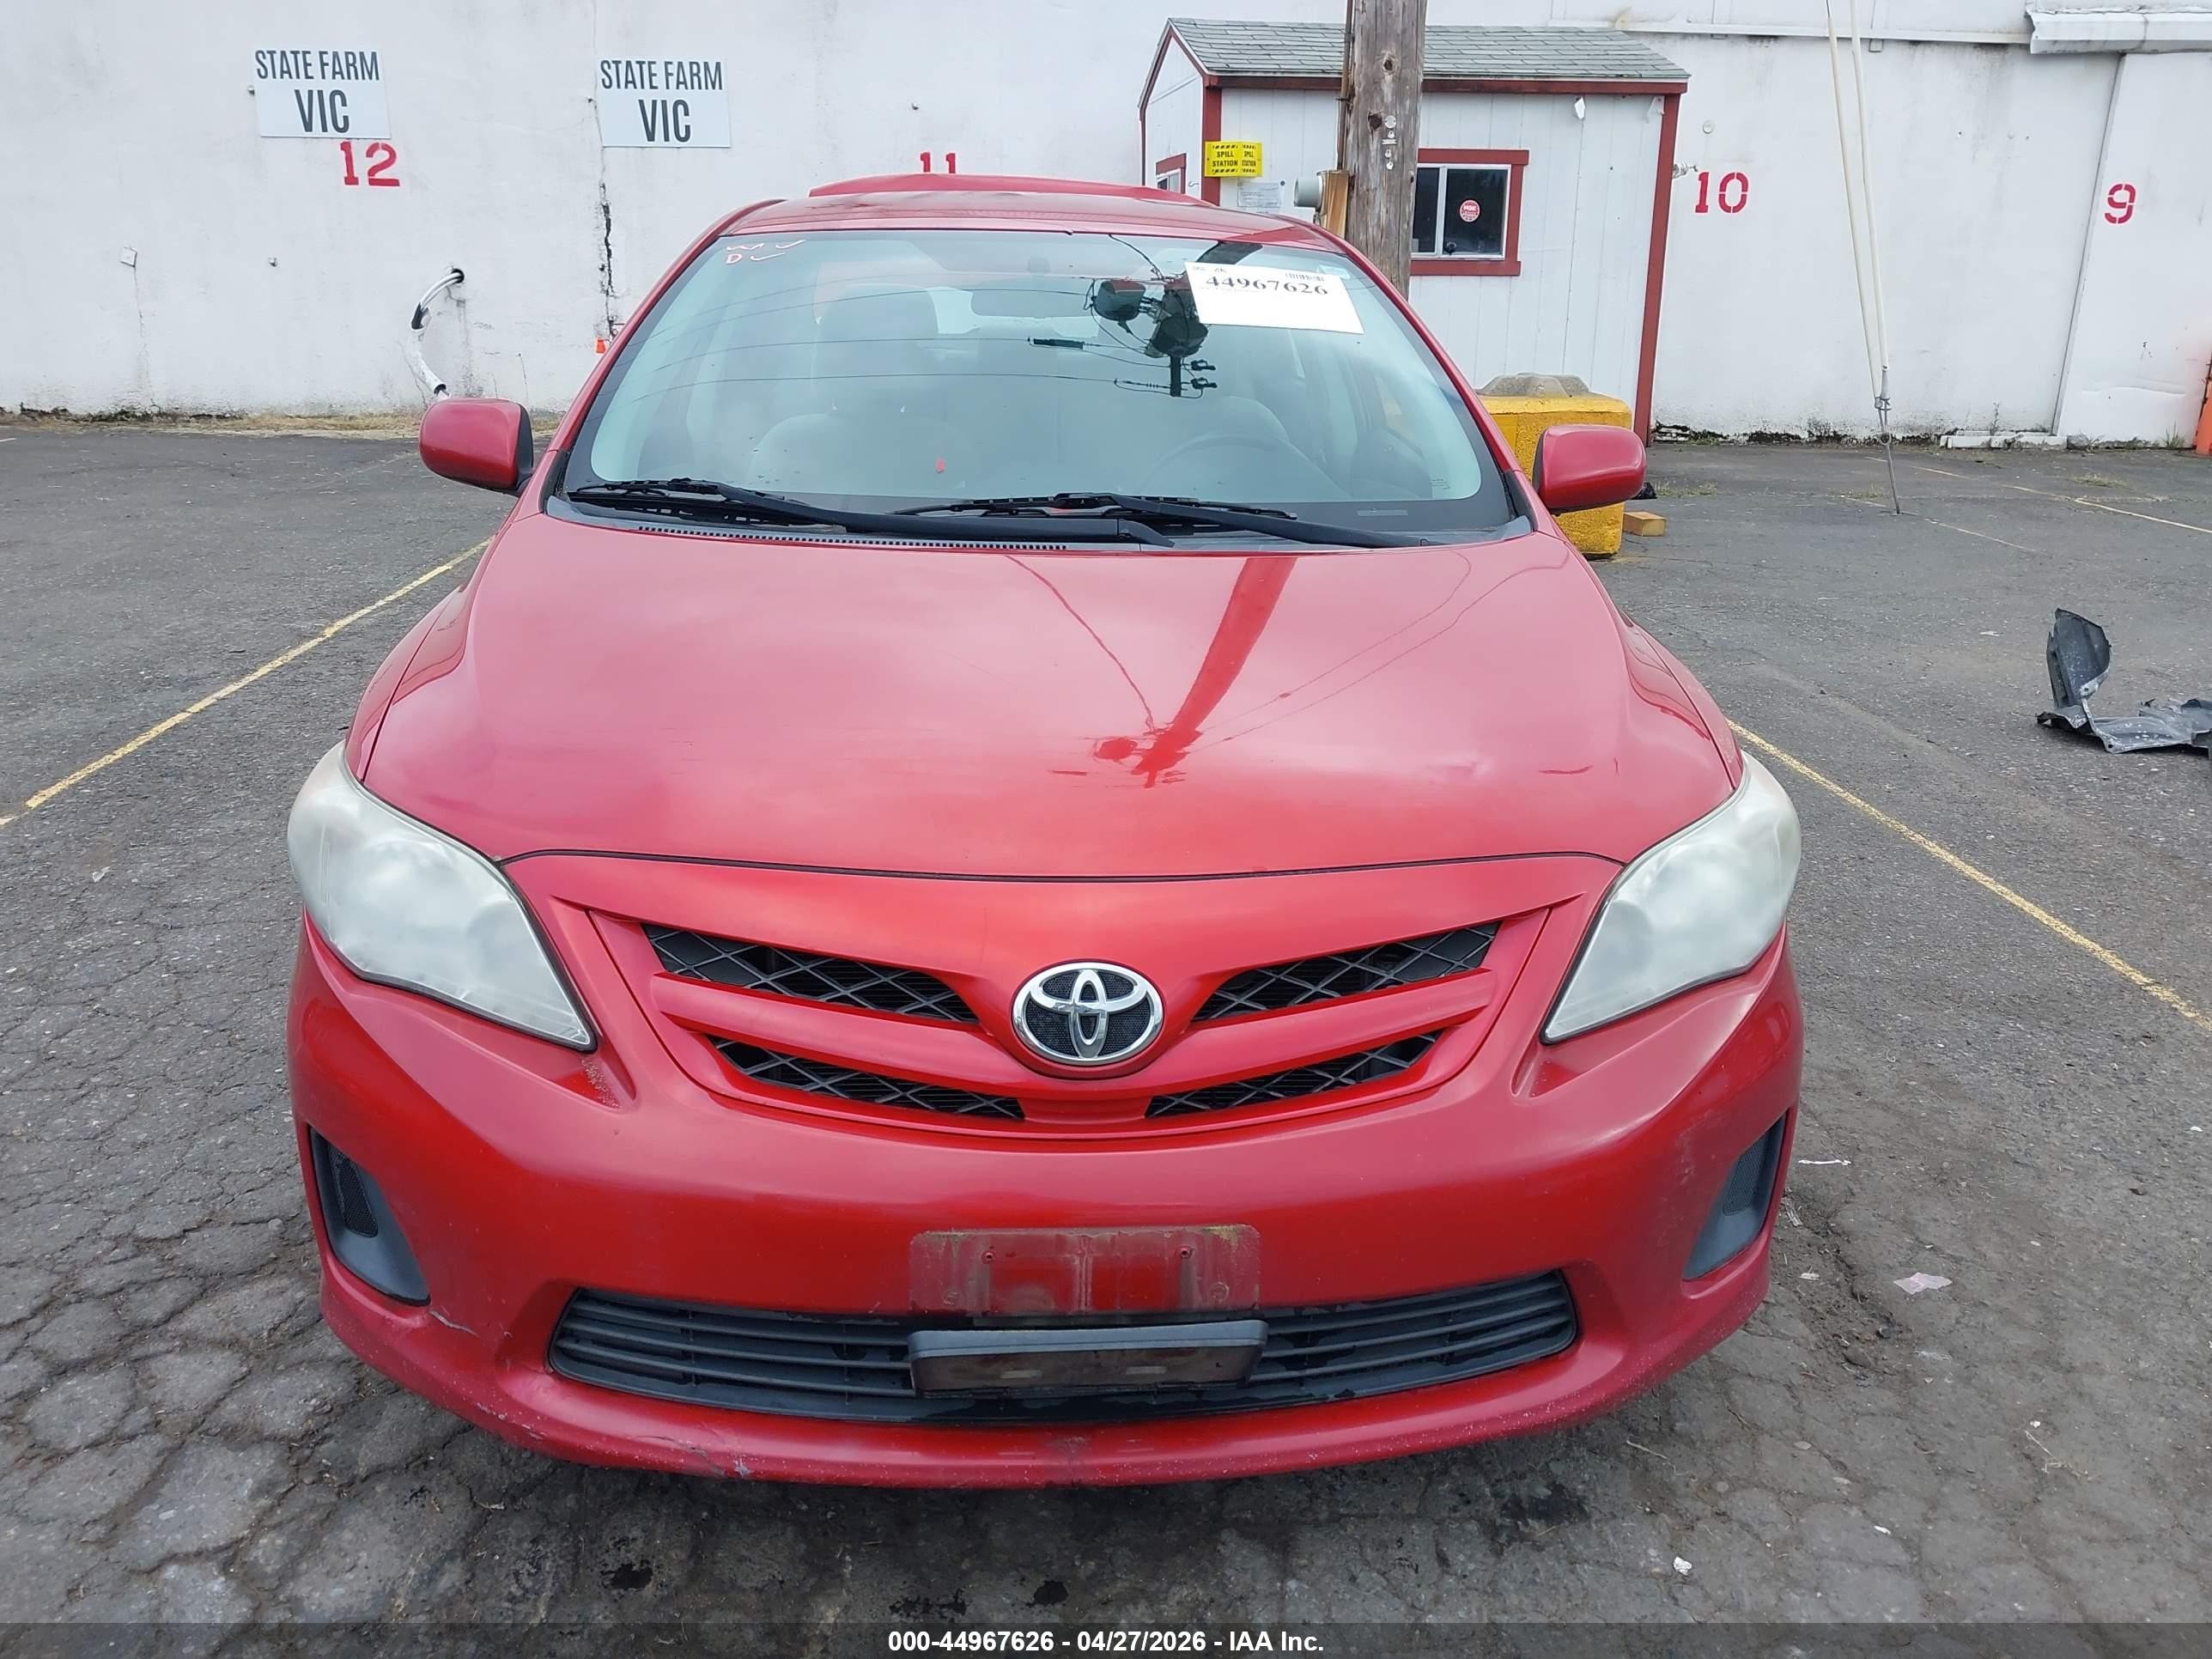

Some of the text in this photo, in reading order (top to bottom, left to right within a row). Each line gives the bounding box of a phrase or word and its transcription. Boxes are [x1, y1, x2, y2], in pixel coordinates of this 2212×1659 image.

[255, 50, 380, 81] STATE FARM
[600, 60, 723, 90] STATE FARM
[294, 88, 349, 133] VIC
[638, 99, 691, 143] VIC
[340, 141, 400, 187] 12
[1695, 171, 1749, 214] 10
[2104, 183, 2136, 224] 9
[1206, 275, 1329, 295] 44967626
